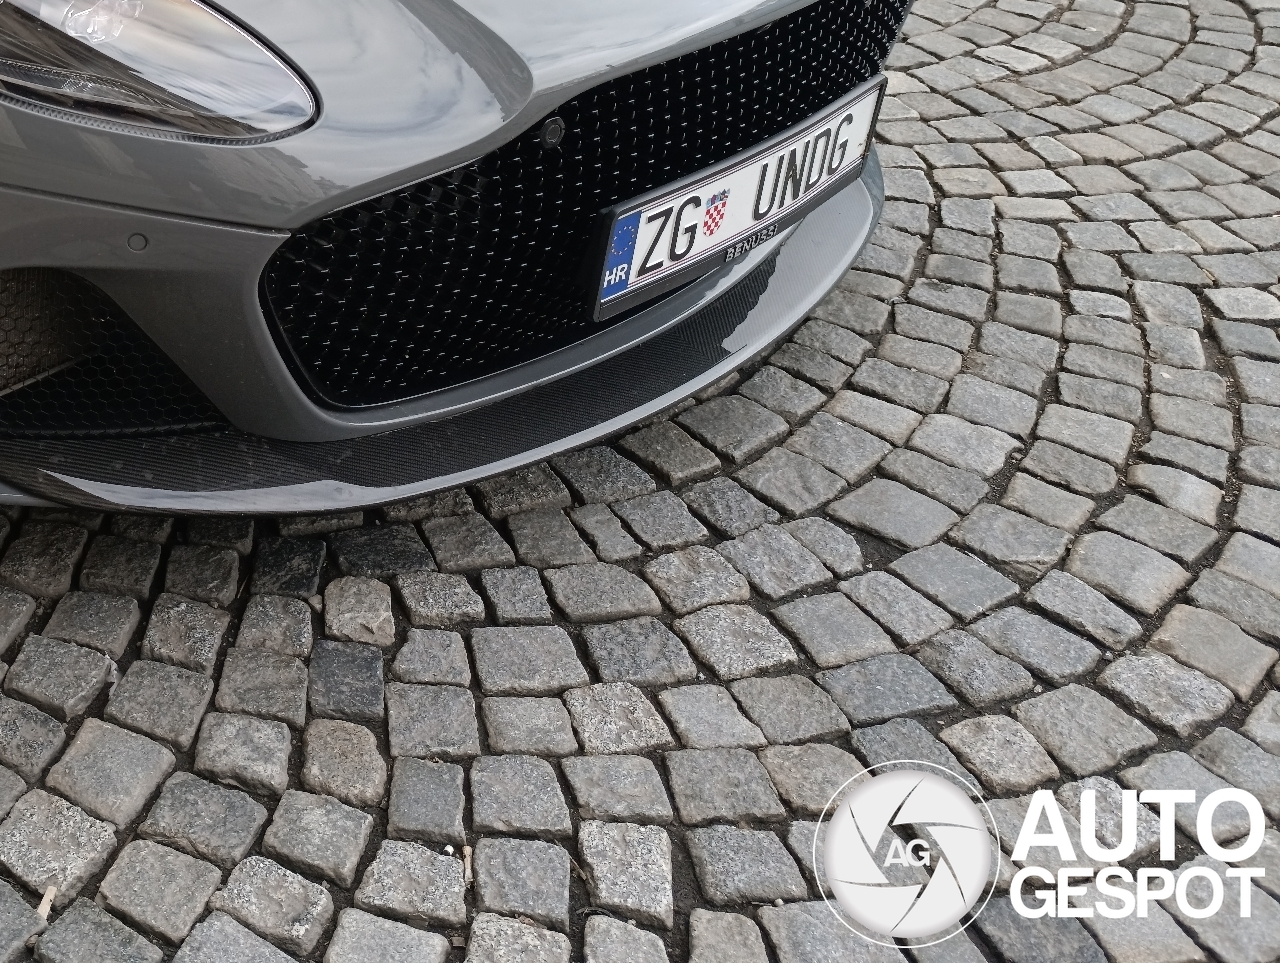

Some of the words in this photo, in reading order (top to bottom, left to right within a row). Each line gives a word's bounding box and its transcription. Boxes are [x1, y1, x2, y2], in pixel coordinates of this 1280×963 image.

[636, 193, 702, 279] ZG
[753, 112, 853, 221] UNDG
[725, 224, 778, 262] BENUSSI
[603, 263, 628, 288] HR
